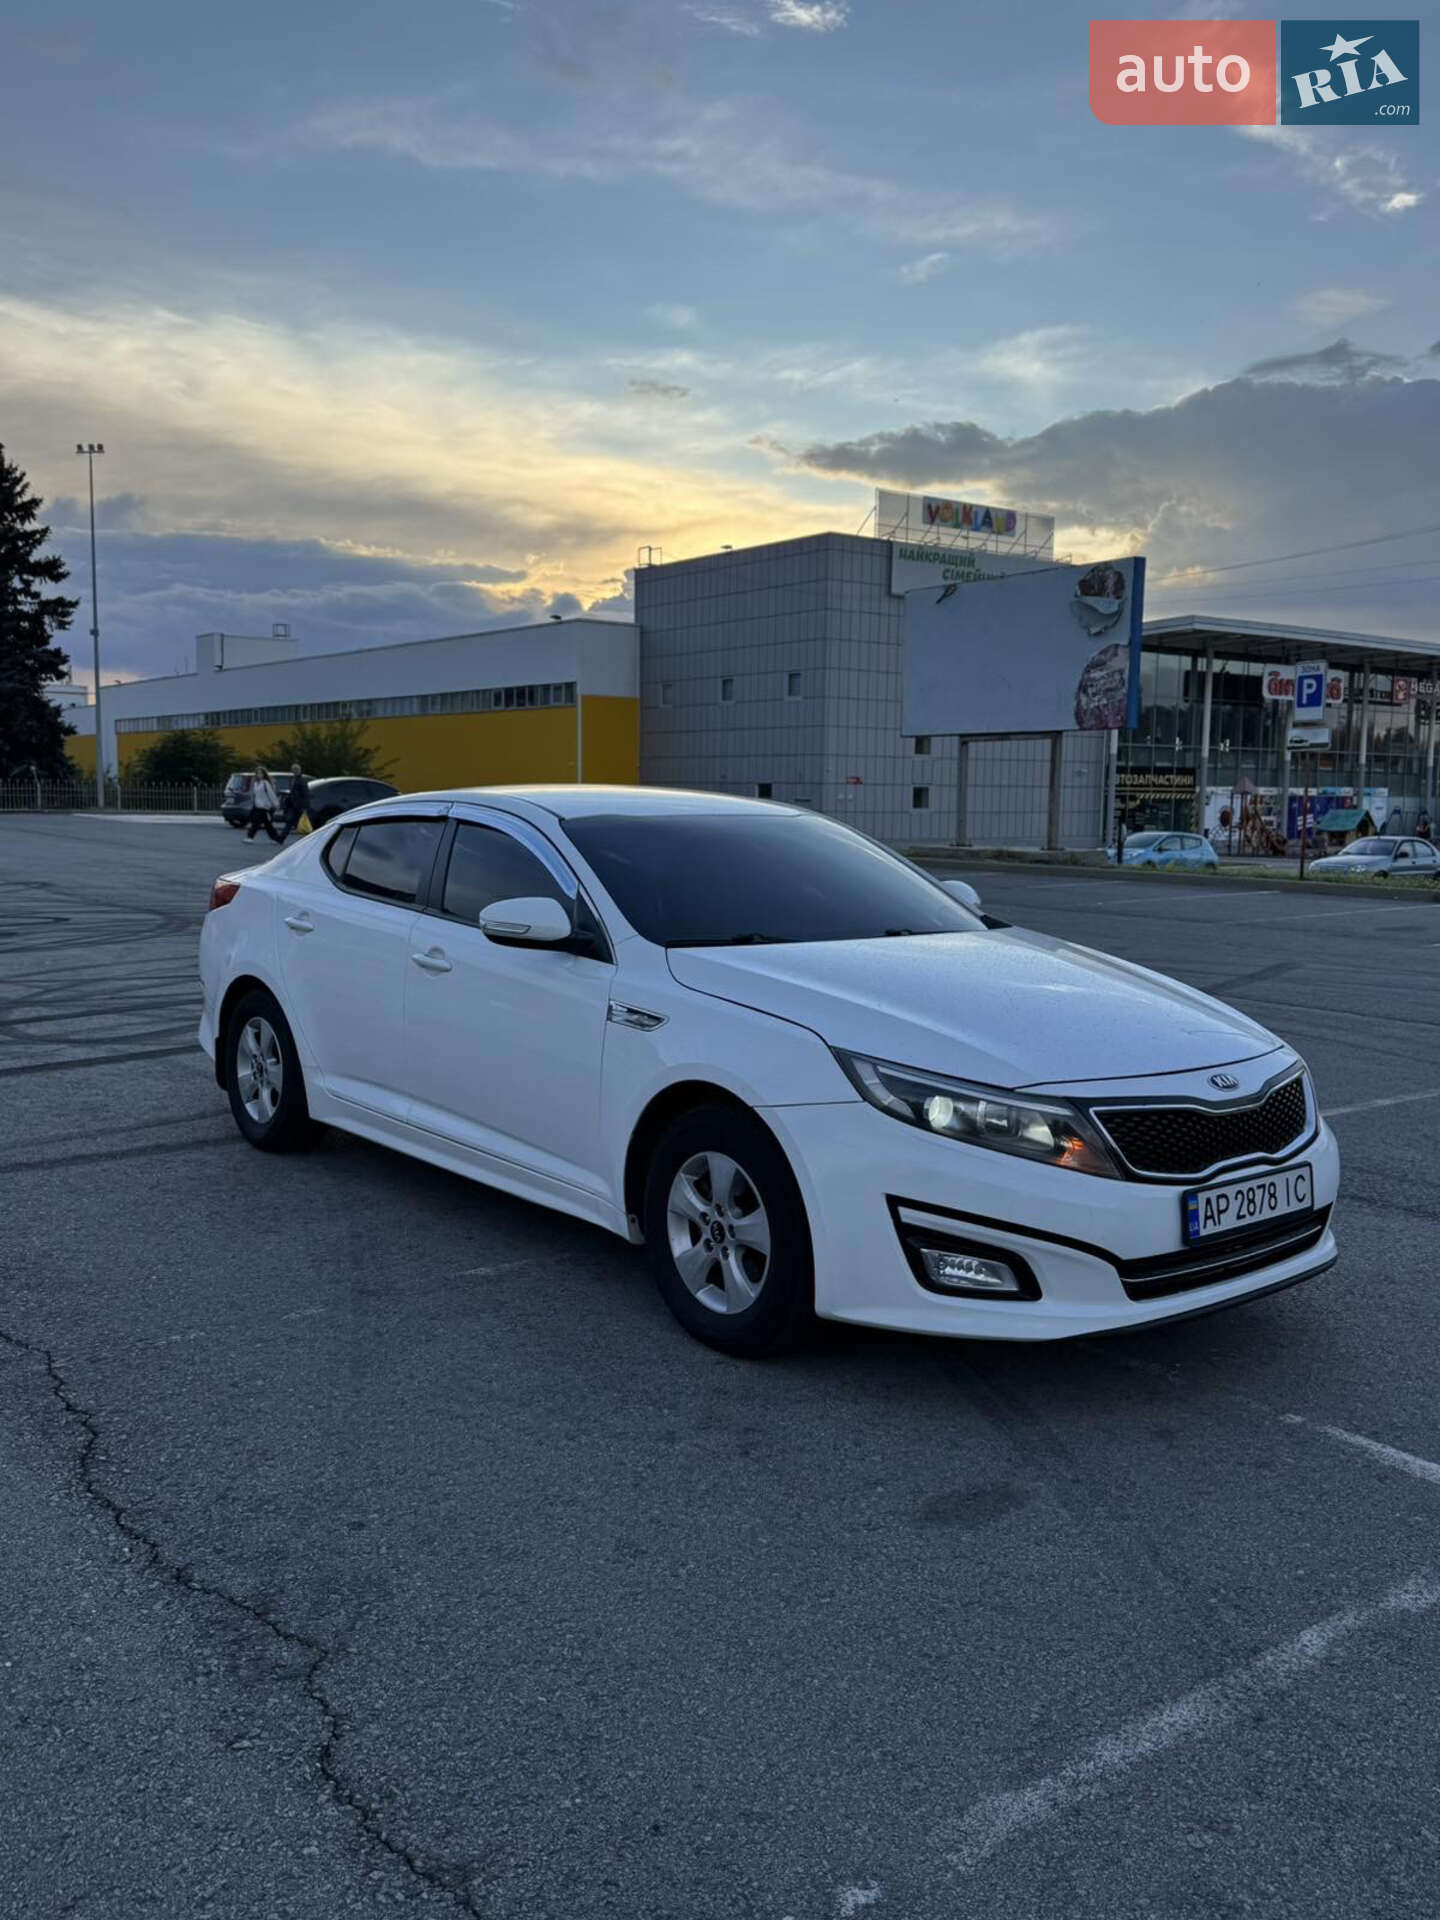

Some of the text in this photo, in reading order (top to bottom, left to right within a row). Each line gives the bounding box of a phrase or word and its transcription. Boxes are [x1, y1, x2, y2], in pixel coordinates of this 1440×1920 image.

[926, 501, 1017, 535] VOLKLAND
[898, 545, 977, 569] НАЙКРАЩИЙ
[1302, 677, 1317, 705] P
[1214, 1075, 1238, 1090] KIA
[1203, 1193, 1230, 1230] AP
[1235, 1181, 1278, 1221] 2878
